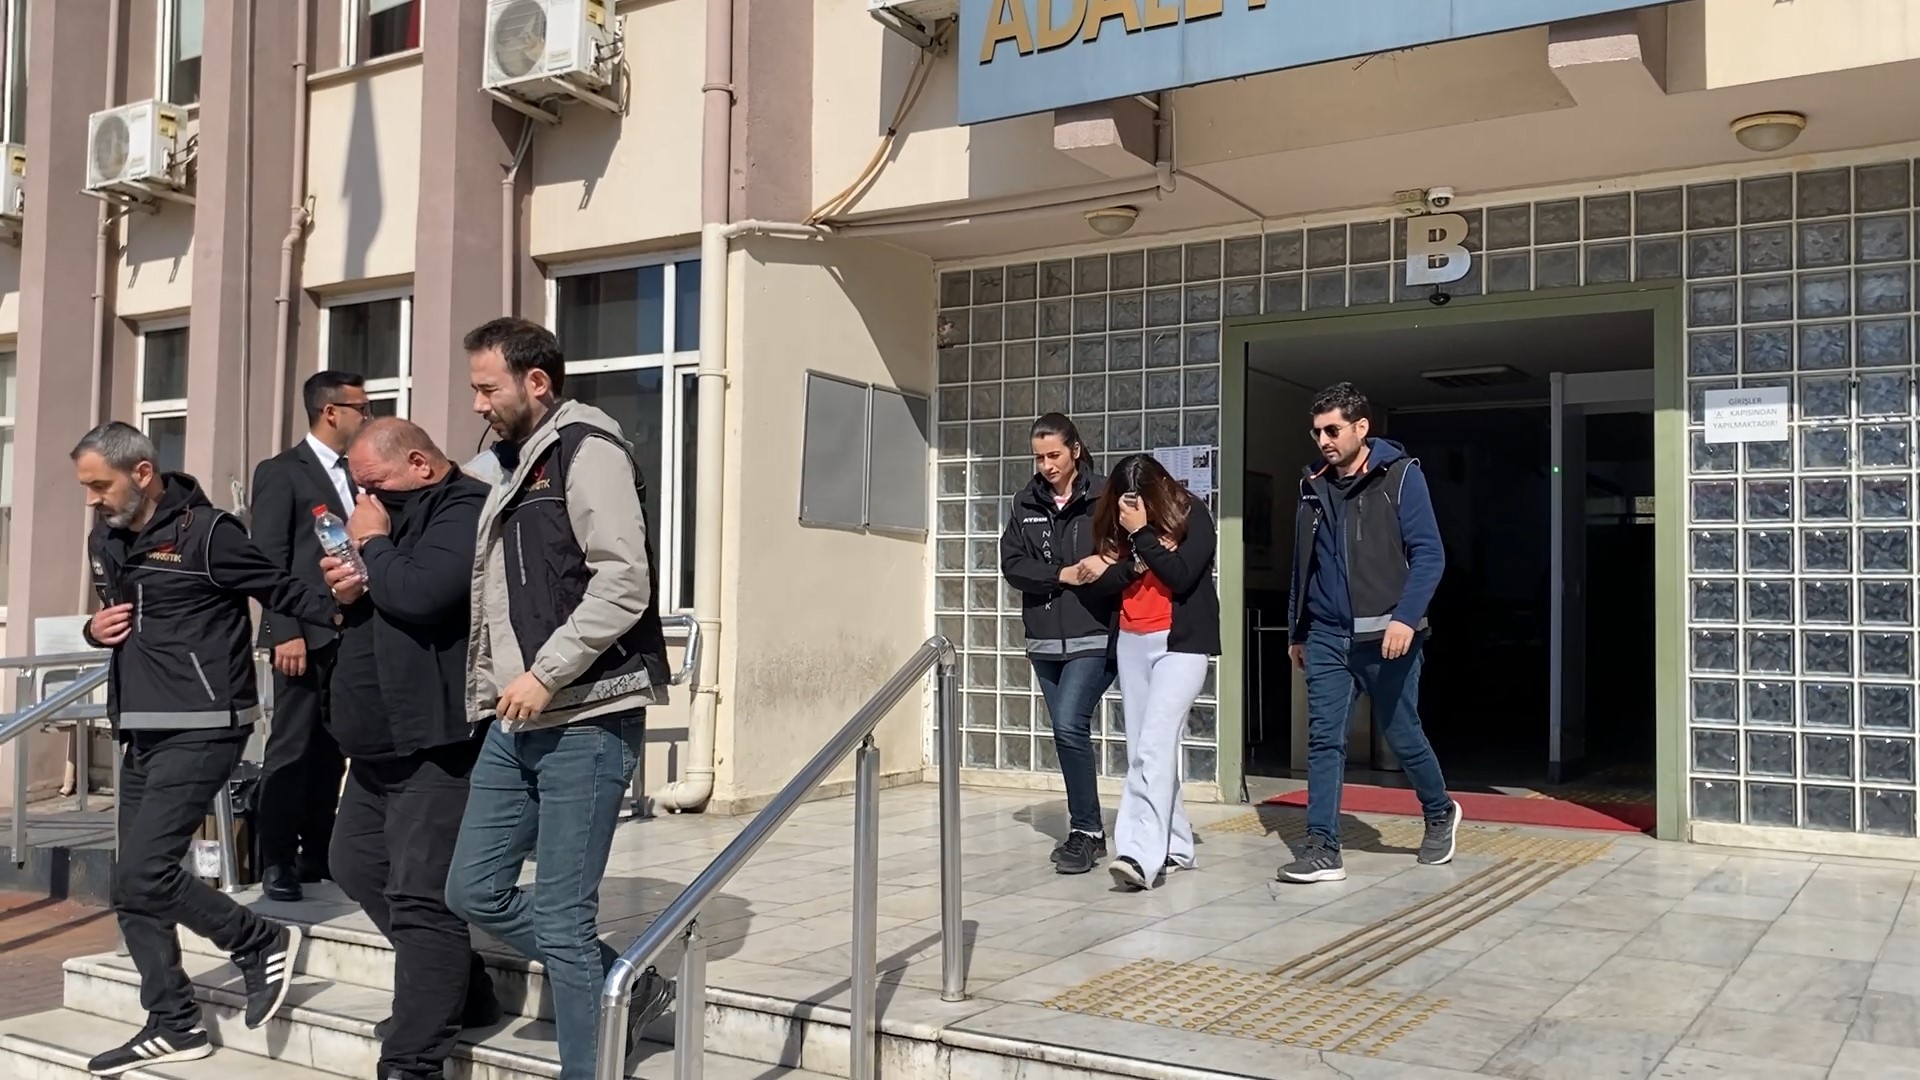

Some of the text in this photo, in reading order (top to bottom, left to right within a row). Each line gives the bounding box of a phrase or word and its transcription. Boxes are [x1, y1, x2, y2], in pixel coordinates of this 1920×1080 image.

[1406, 212, 1470, 286] B
[1730, 408, 1777, 416] KAPISINDAN
[1022, 516, 1048, 524] AYDIN
